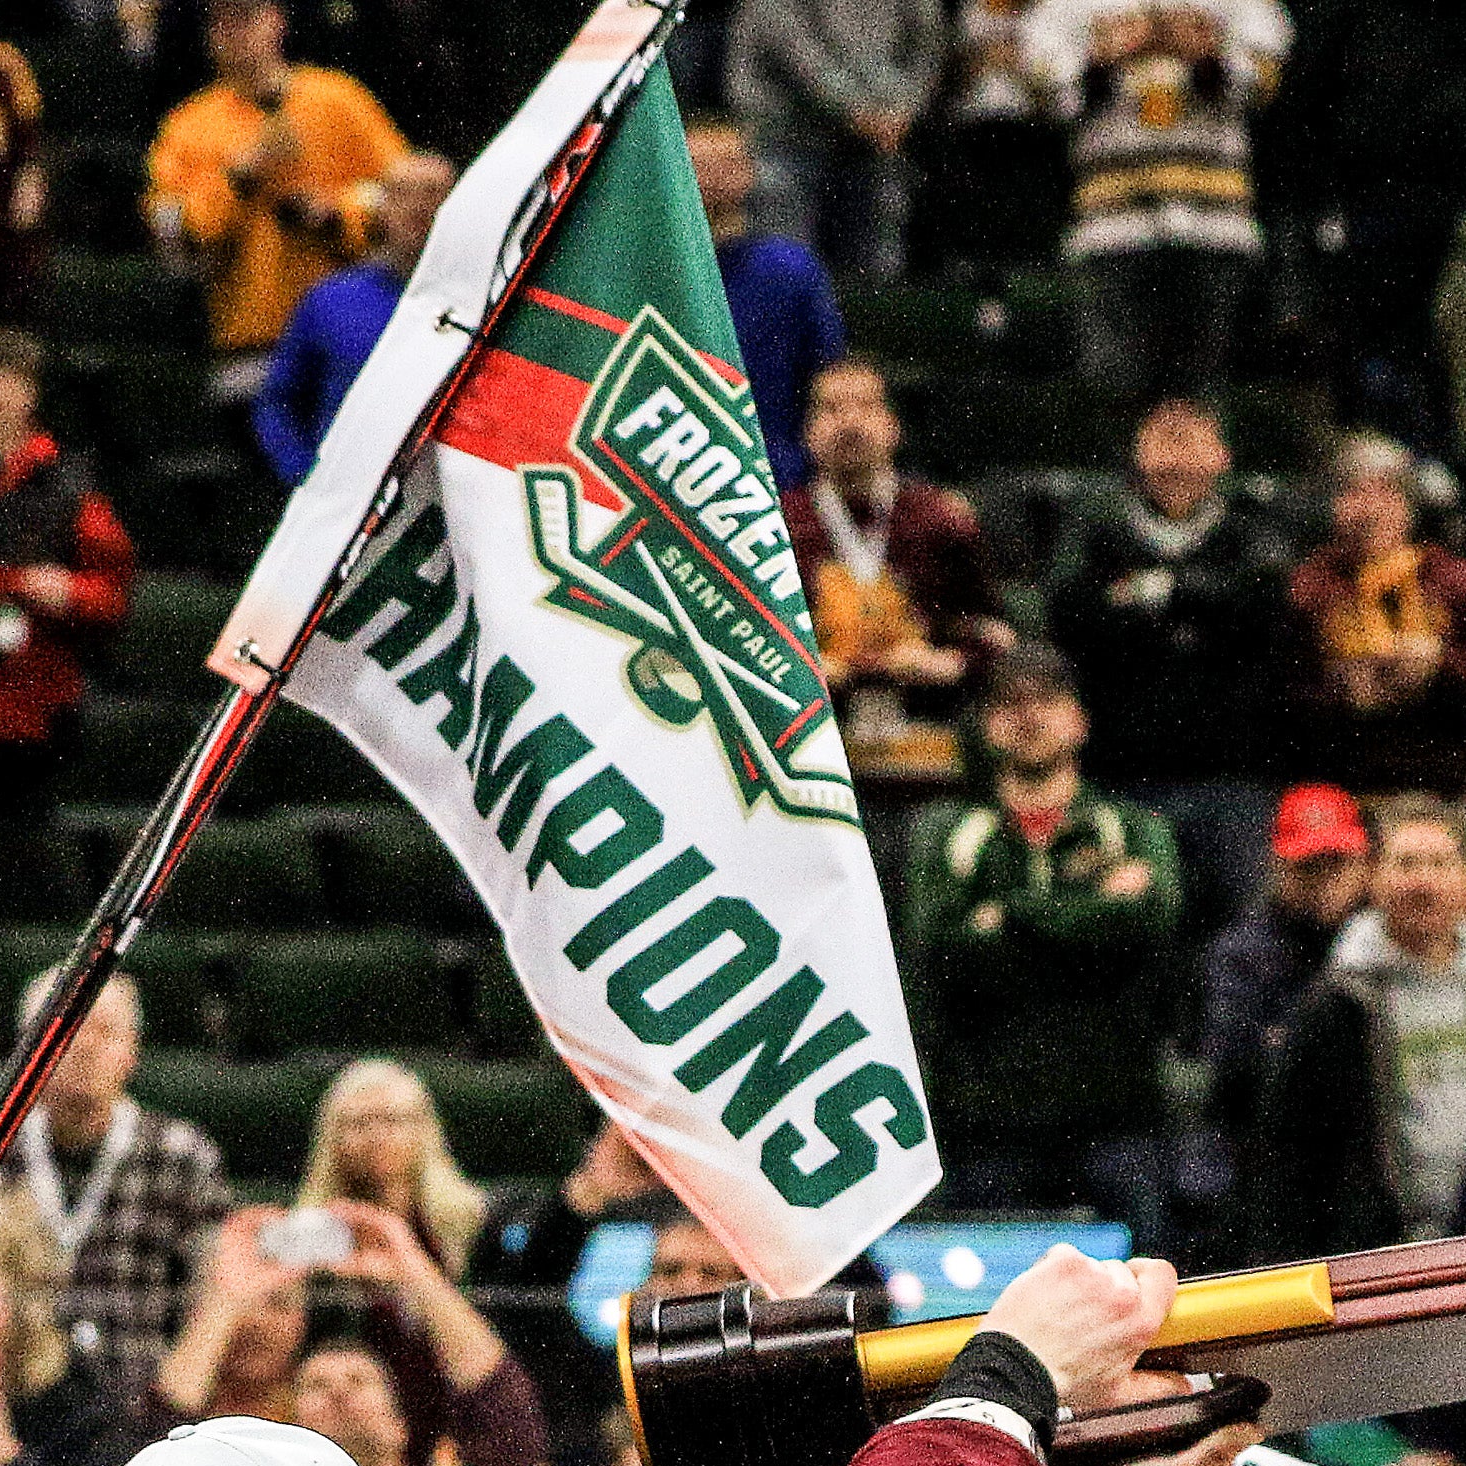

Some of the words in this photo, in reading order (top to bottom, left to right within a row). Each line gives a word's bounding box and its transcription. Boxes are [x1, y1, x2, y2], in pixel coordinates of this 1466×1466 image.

[659, 545, 736, 620] SAINT
[730, 618, 793, 684] PAUL
[316, 503, 928, 1209] HAMPIONS
